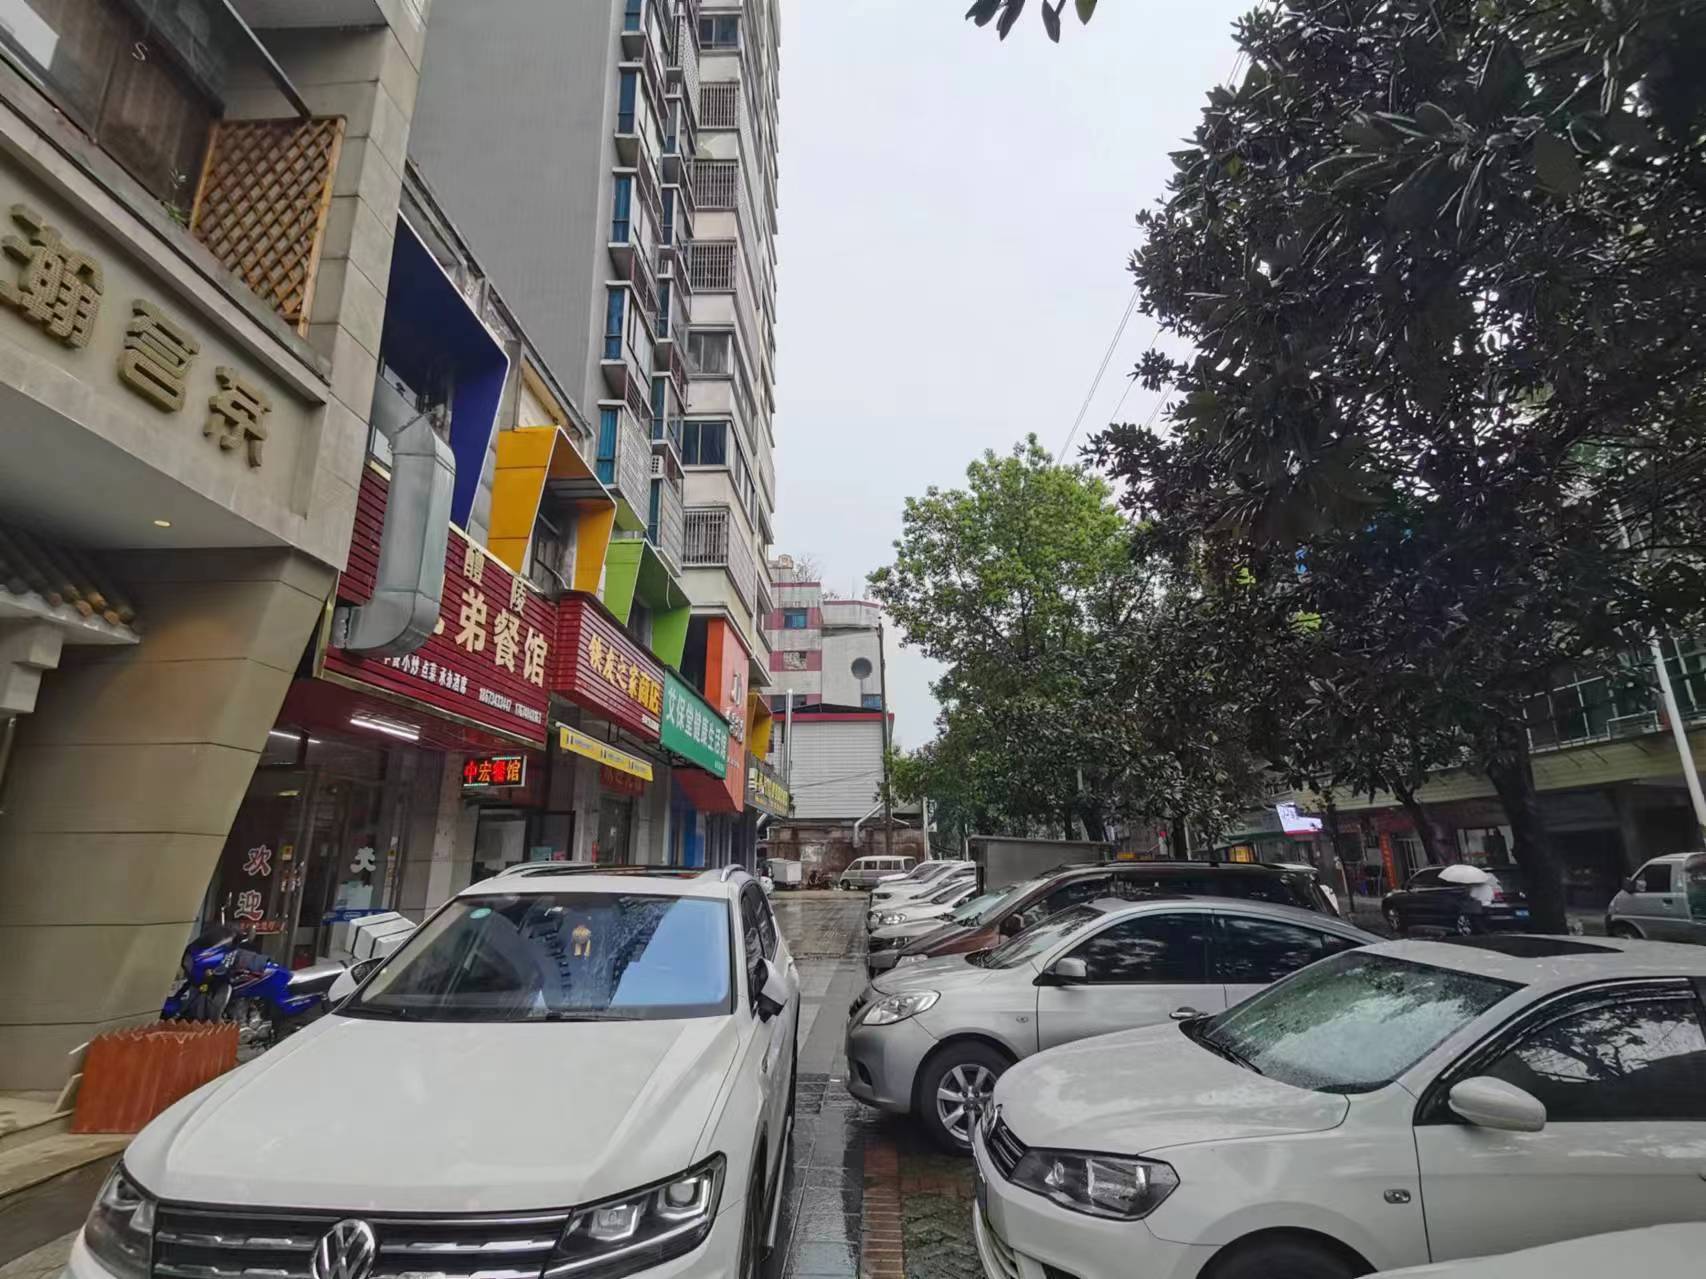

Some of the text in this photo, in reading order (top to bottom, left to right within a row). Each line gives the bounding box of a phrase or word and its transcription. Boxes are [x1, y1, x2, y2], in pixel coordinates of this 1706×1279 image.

[434, 587, 548, 688] 弟餐馆
[464, 760, 521, 783] 中宏餐馆
[234, 844, 272, 921] 欢迎
